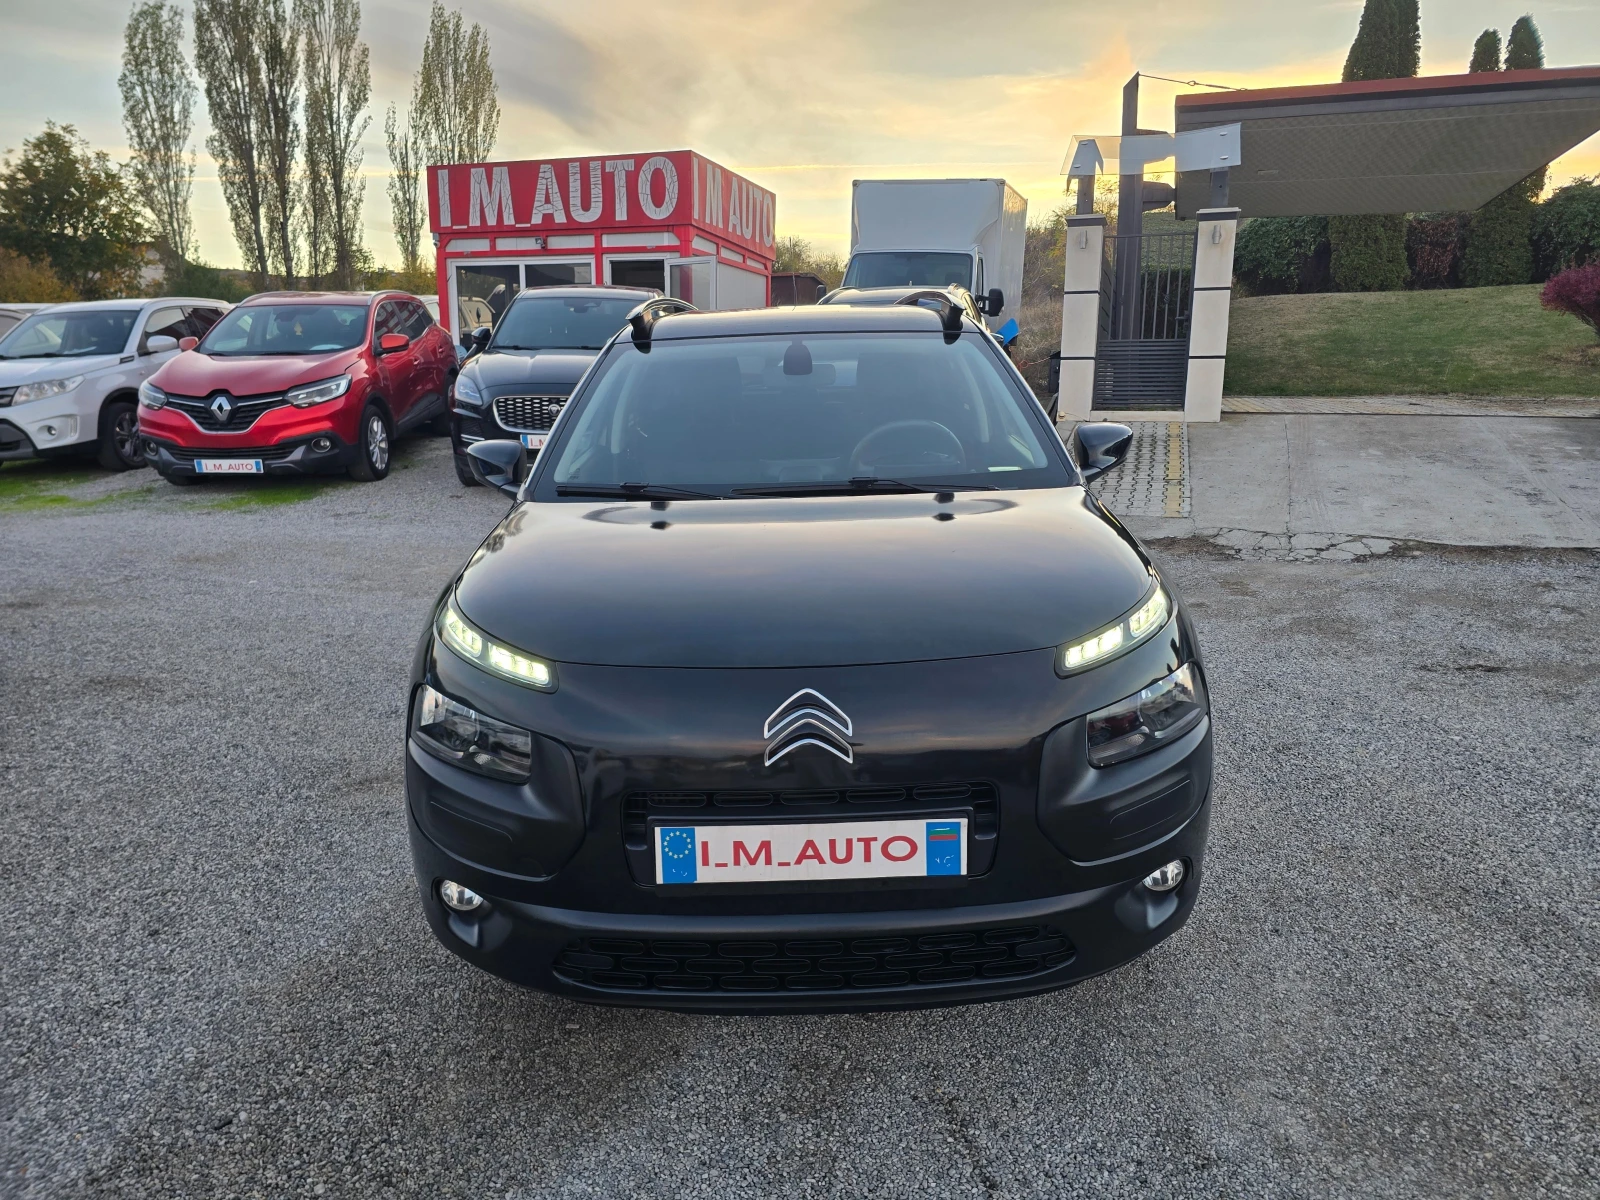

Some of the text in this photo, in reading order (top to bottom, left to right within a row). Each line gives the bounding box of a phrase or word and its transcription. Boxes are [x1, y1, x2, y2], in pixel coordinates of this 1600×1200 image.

[705, 163, 723, 229] M
[728, 176, 773, 248] AUTO
[701, 835, 918, 868] I_M_AUTO
